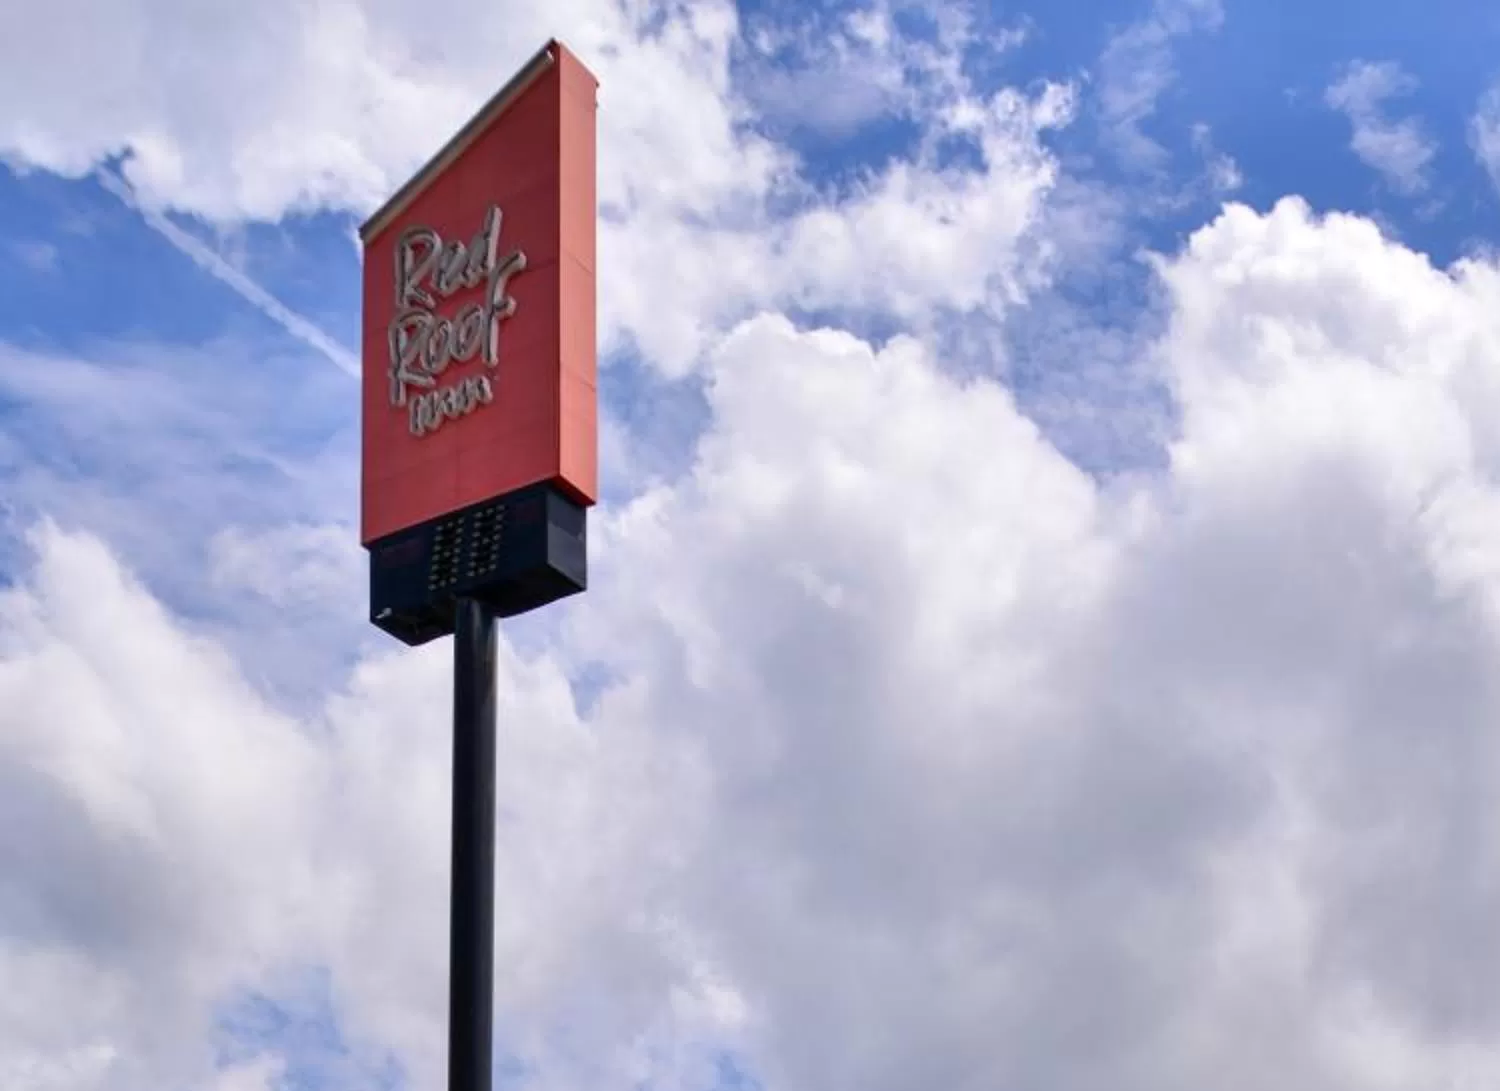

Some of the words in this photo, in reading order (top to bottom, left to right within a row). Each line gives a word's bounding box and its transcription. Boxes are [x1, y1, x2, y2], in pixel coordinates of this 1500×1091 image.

[394, 204, 503, 310] Red
[388, 250, 528, 408] Roof
[408, 375, 493, 436] Inn
